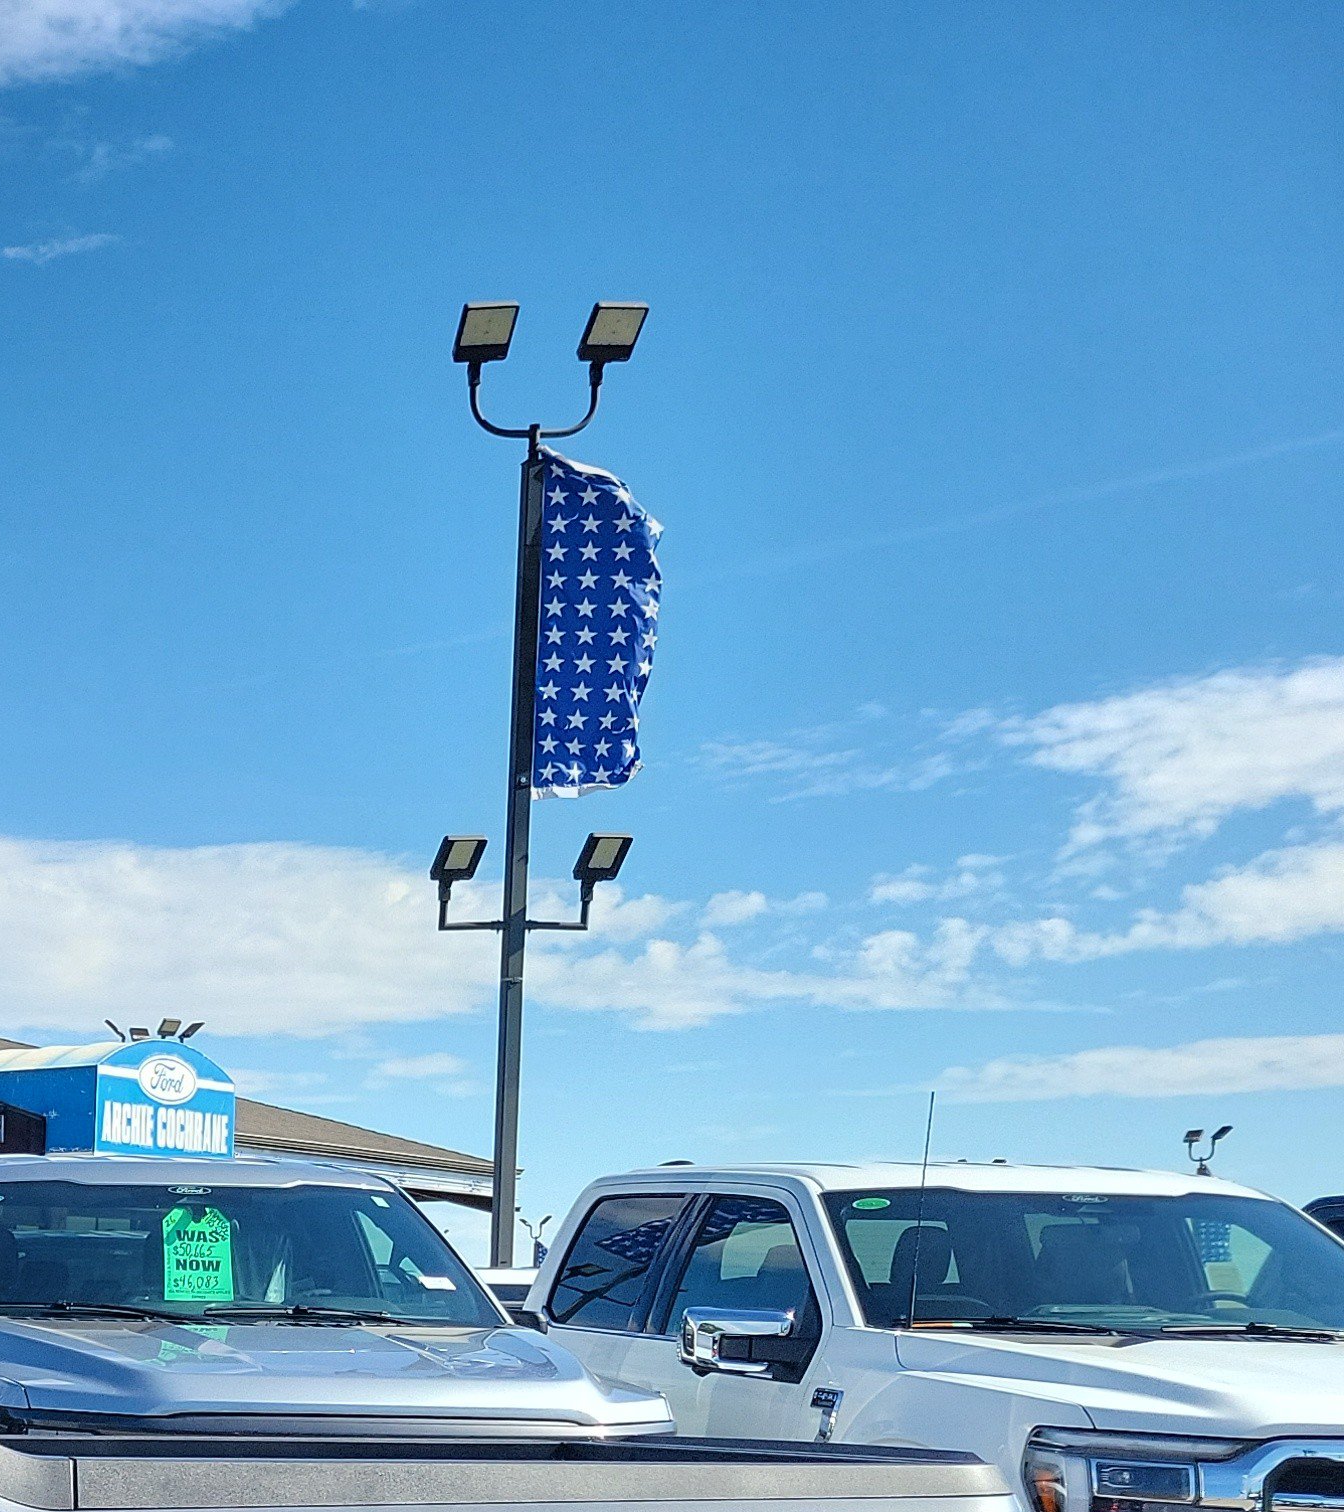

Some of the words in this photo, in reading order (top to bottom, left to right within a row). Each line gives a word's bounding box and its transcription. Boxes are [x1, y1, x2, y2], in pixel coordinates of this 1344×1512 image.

[149, 1062, 185, 1094] Ford
[100, 1099, 155, 1148] ARCHIE
[156, 1107, 230, 1154] COCHRANE
[175, 1230, 221, 1243] WAS
[172, 1242, 217, 1260] $50,665
[175, 1258, 222, 1272] NOW
[173, 1274, 219, 1292] $46,083
